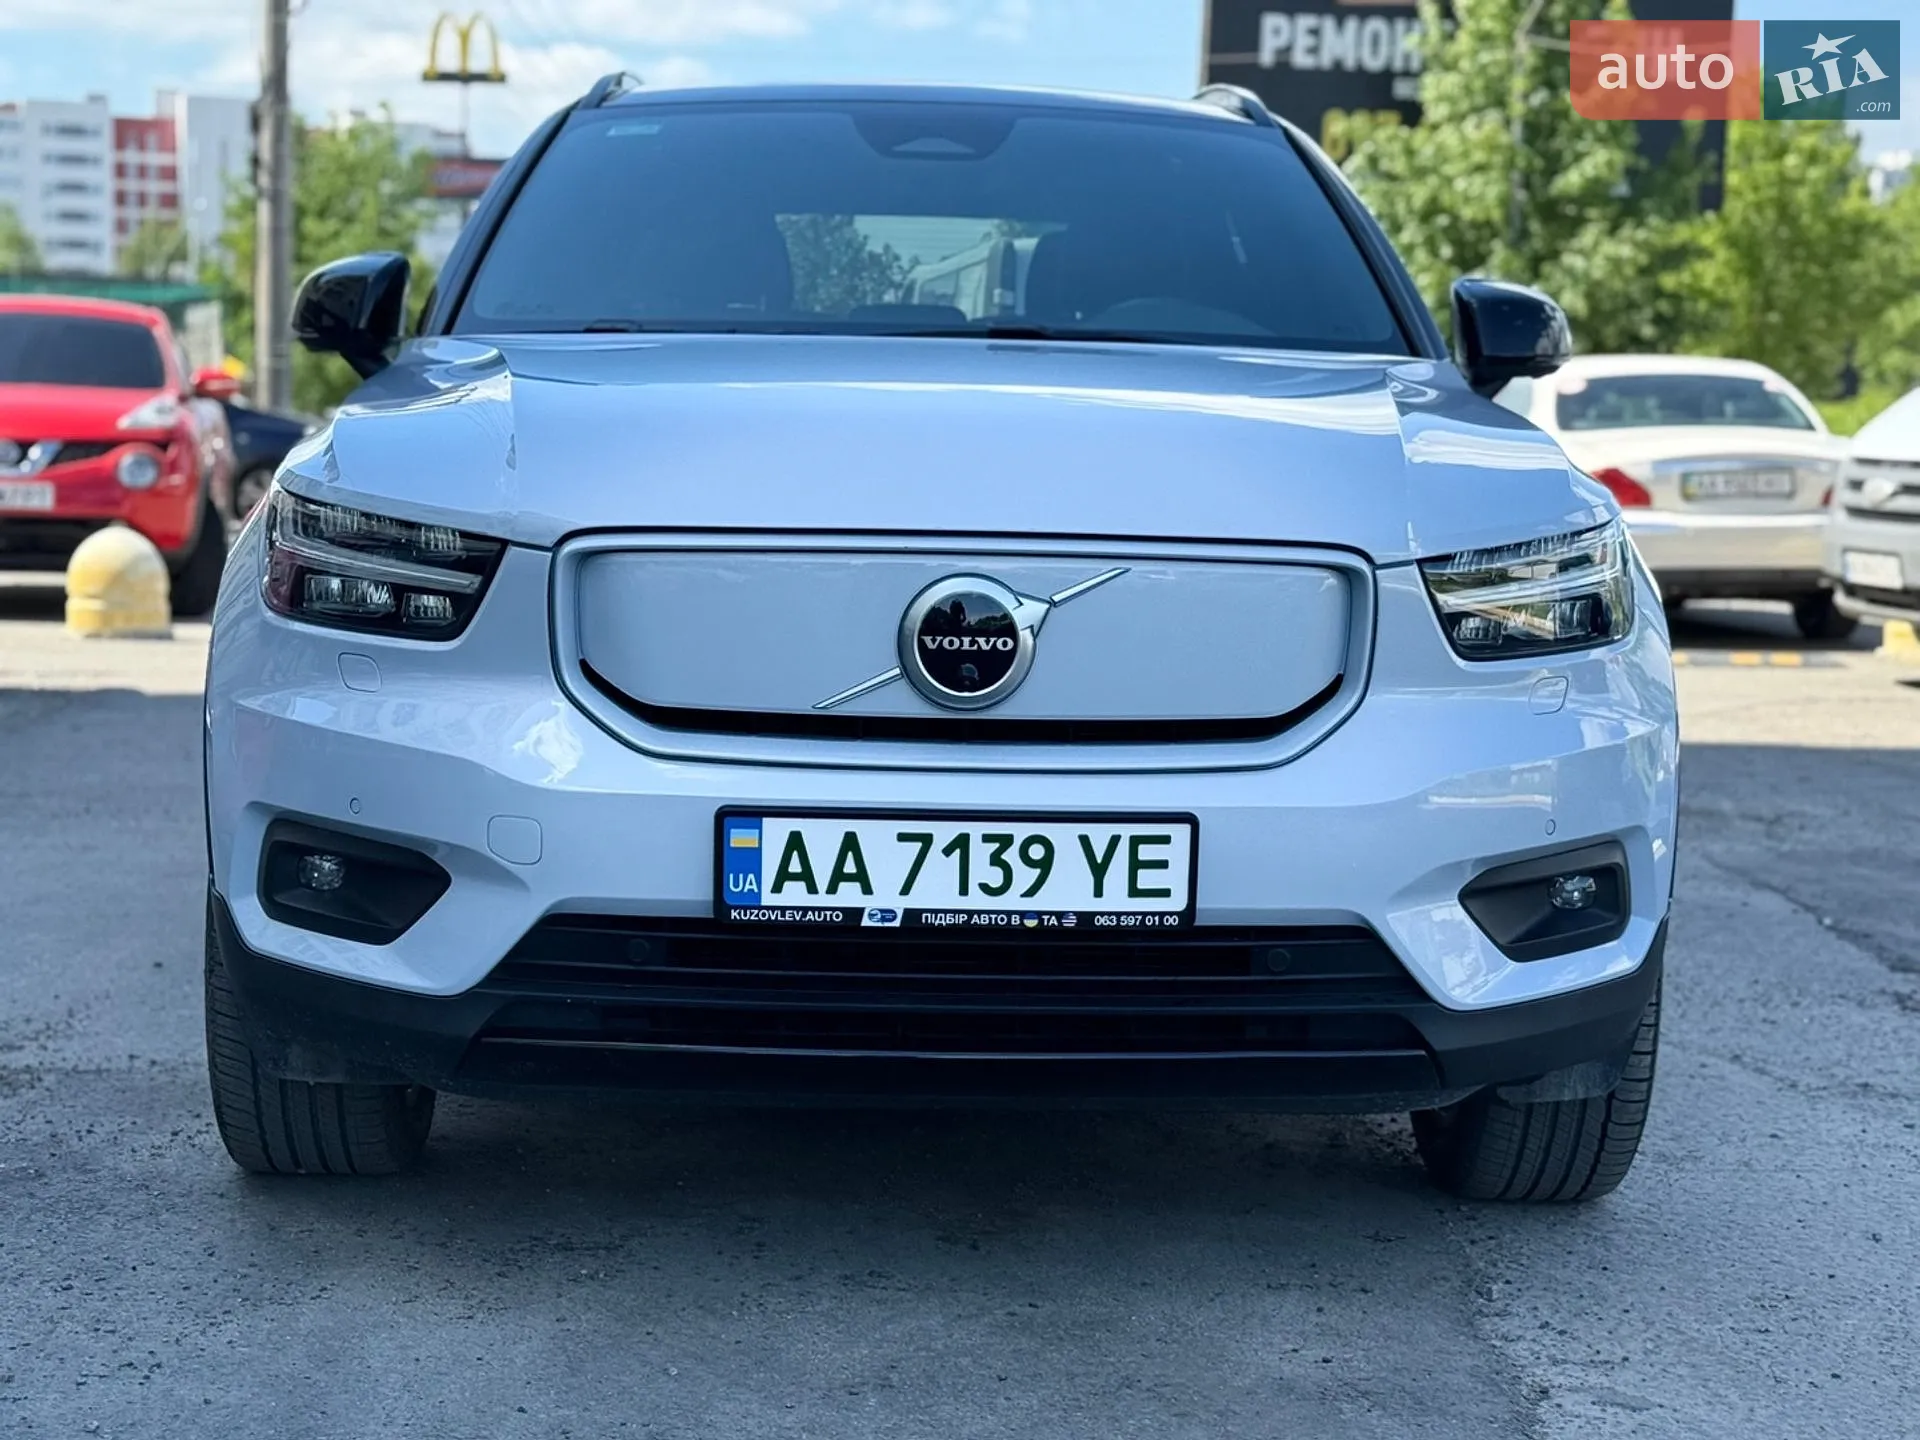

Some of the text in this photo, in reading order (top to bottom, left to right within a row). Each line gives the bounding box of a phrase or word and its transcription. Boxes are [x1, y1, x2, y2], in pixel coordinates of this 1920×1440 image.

[1258, 12, 1453, 73] РЕМОН
[920, 635, 1015, 651] VOLVO
[770, 830, 1172, 899] AA 7139 YE
[729, 872, 759, 893] UA
[730, 909, 843, 922] KUZOVLEV.AUTO
[921, 912, 968, 926] ПІДБІР
[970, 914, 1008, 926] АВТО
[1094, 915, 1179, 927] 063 597 01 00
